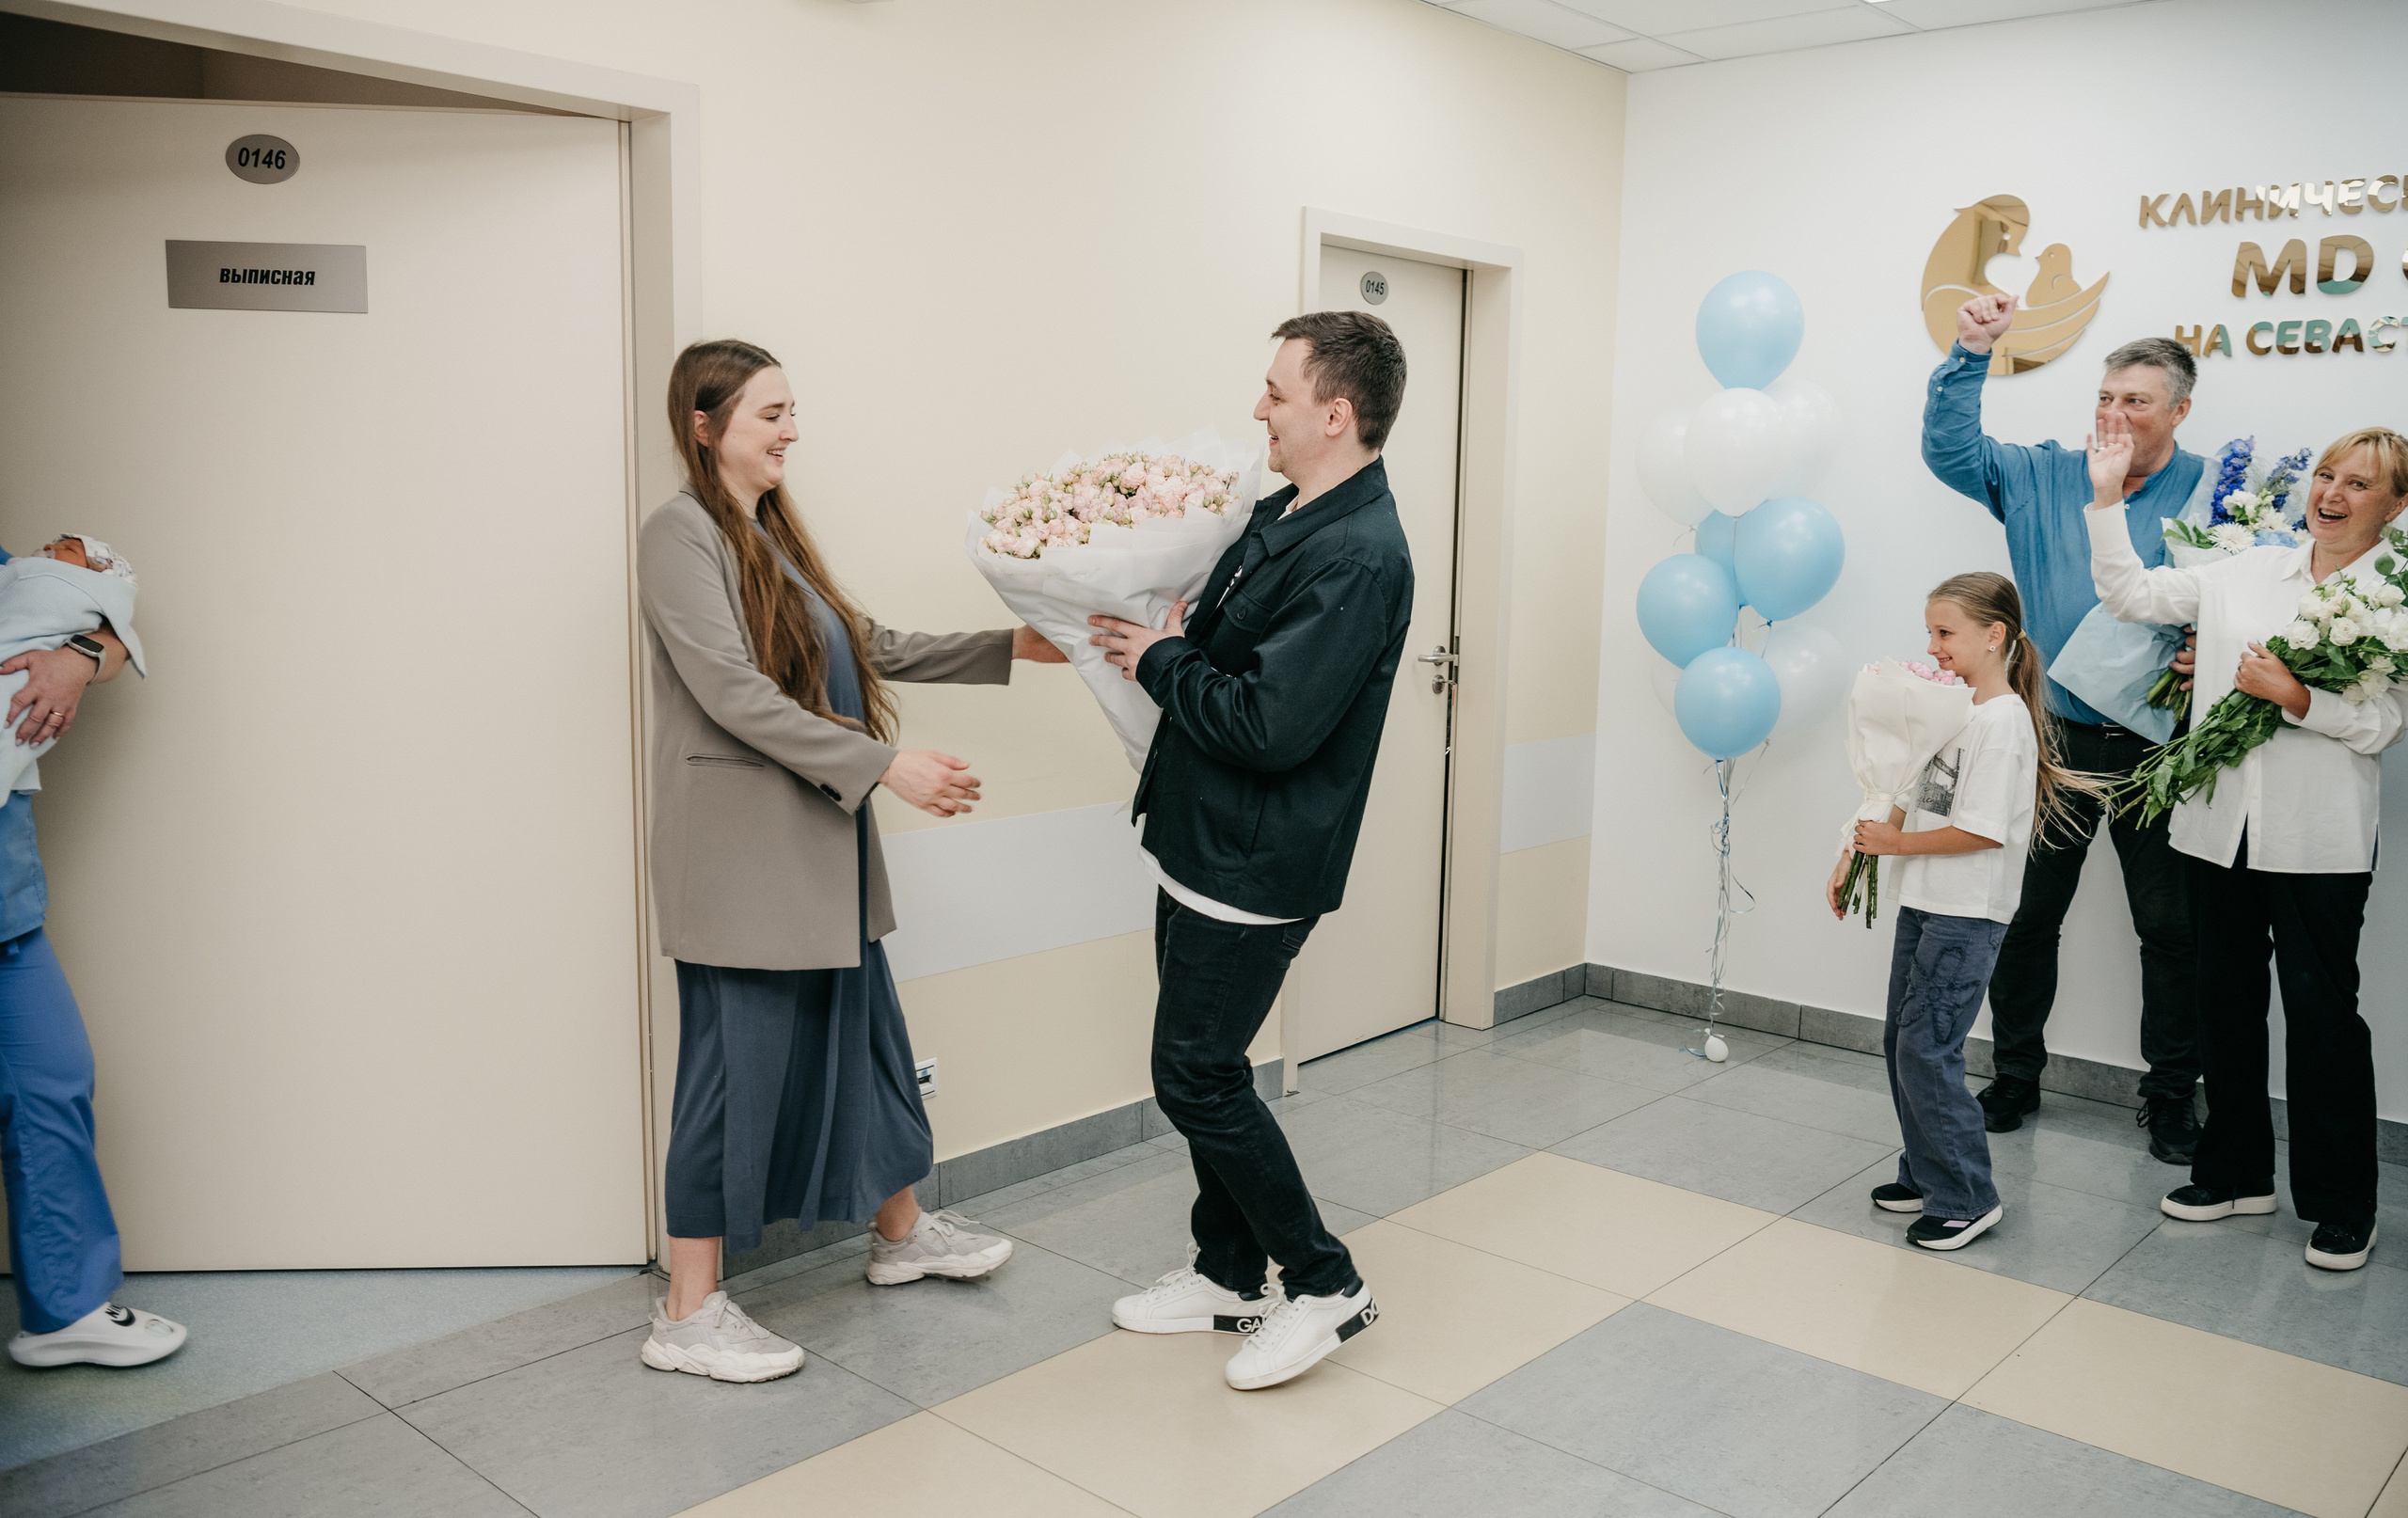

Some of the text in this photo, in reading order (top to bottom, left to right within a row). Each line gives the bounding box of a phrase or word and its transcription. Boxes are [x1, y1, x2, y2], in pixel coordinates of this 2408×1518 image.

[237, 147, 287, 170] 0146
[2138, 174, 2408, 229] КЛИНИЧЕС
[2231, 234, 2374, 298] MD
[1365, 279, 1385, 295] 0145
[2175, 324, 2232, 357] НА
